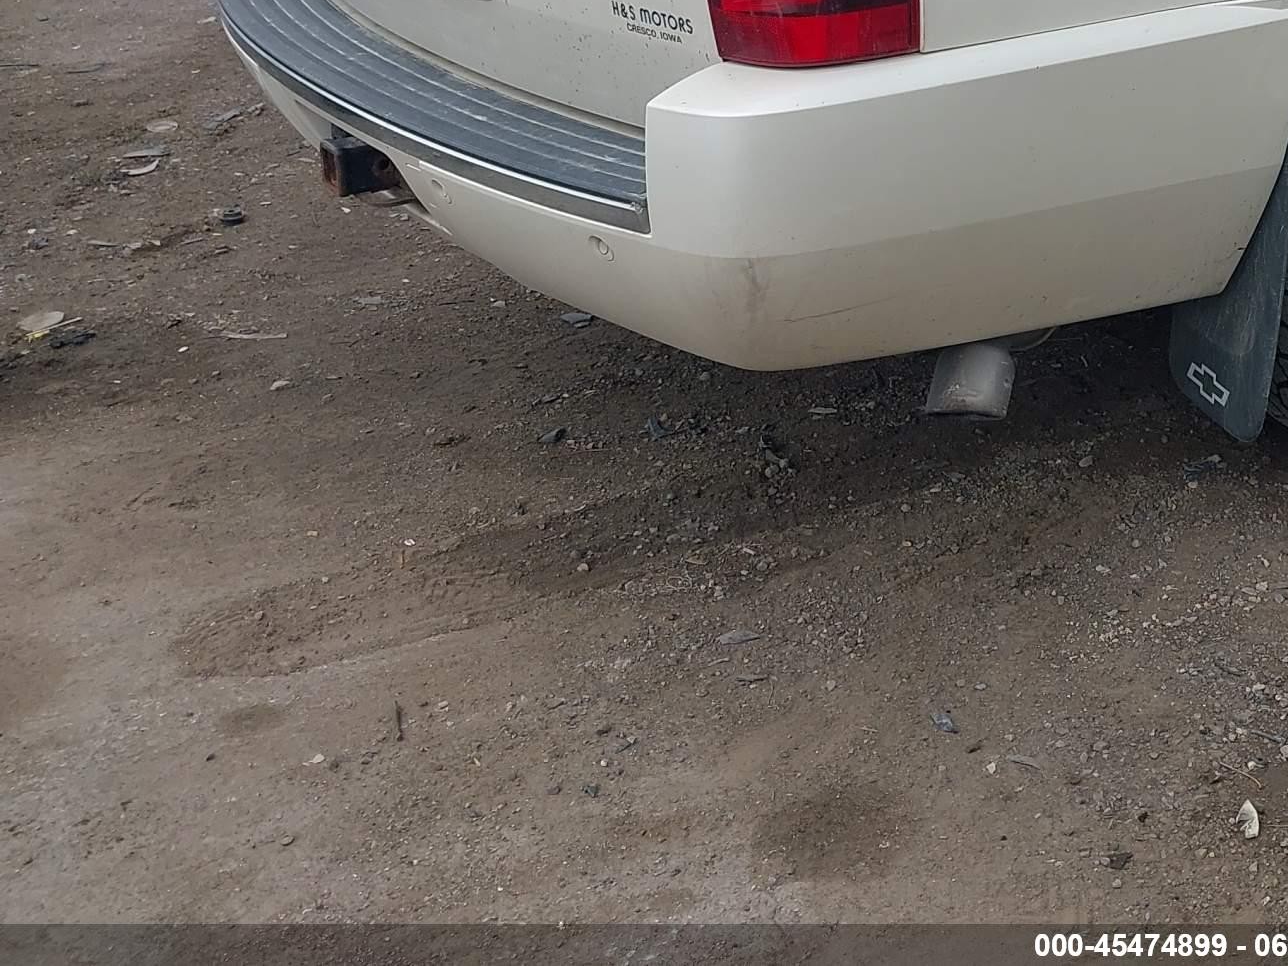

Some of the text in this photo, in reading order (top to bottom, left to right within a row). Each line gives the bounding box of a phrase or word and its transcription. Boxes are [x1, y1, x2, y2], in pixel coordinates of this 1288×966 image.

[611, 0, 693, 35] H&S MOTORS
[660, 32, 682, 44] IOWA
